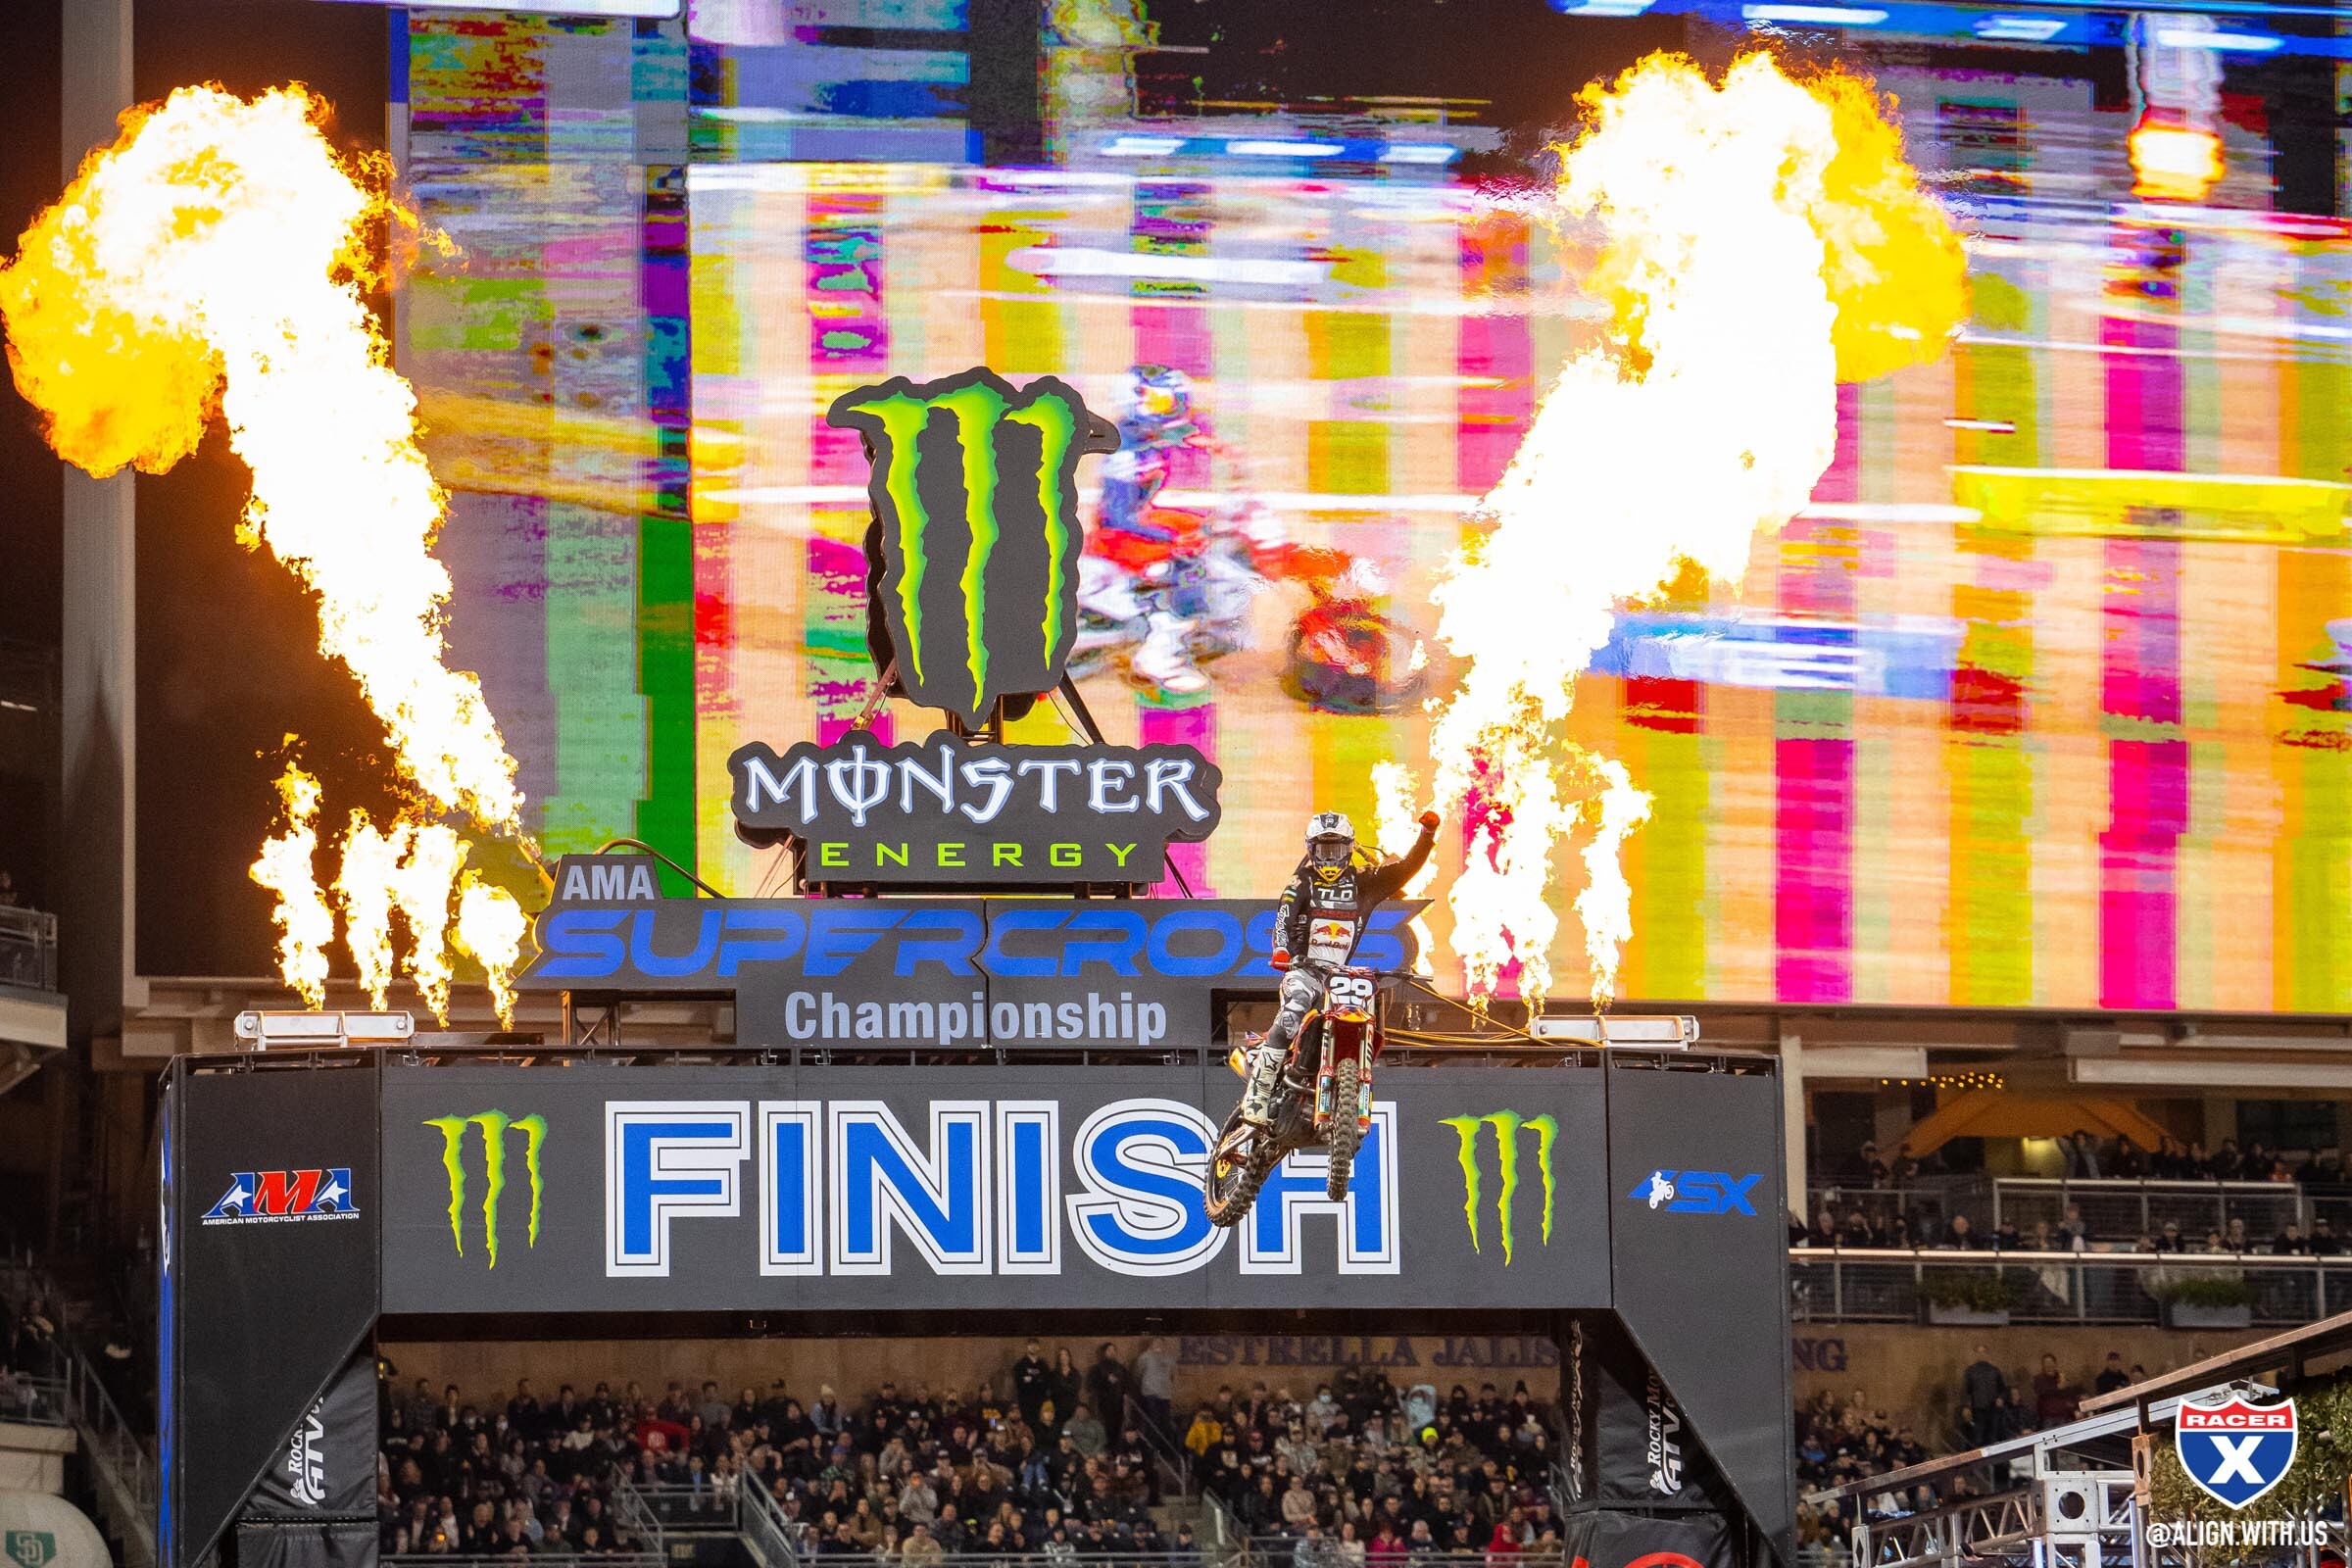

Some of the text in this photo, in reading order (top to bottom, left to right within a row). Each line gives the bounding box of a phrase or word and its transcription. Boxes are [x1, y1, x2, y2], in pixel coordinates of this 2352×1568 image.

[742, 744, 1211, 828] MONSTER
[821, 842, 1138, 867] ENERGY
[562, 864, 656, 901] AMA
[1317, 887, 1353, 901] TLD
[1329, 976, 1373, 1005] 29
[785, 991, 1168, 1046] Championship
[201, 1167, 361, 1218] AMA
[606, 1098, 1401, 1276] FINISH
[202, 1212, 360, 1226] AMERICAN MOTORCYCLIST ASSOCIATION
[1176, 1335, 1420, 1367] ESTRELLA
[288, 1423, 304, 1475] ROC
[1647, 1409, 1661, 1467] ROCKY
